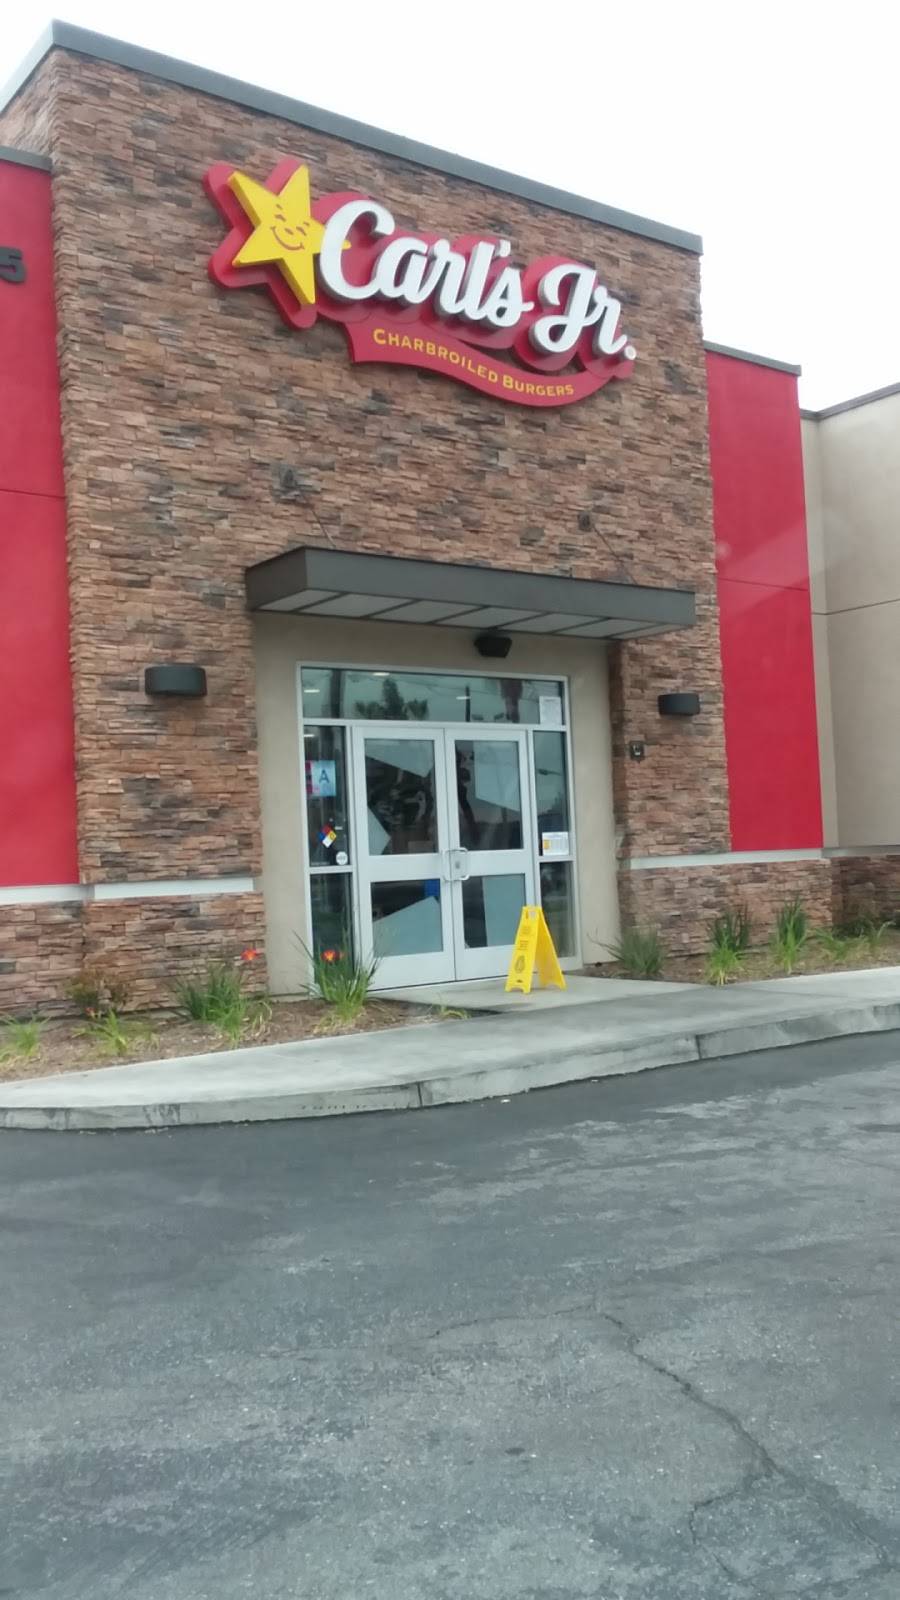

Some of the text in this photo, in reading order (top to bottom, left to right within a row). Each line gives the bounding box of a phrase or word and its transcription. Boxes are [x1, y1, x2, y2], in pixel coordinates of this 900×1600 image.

[319, 200, 638, 361] Carl's Jr.
[372, 328, 574, 396] CHARBROILED BURGERS
[319, 769, 330, 784] A
